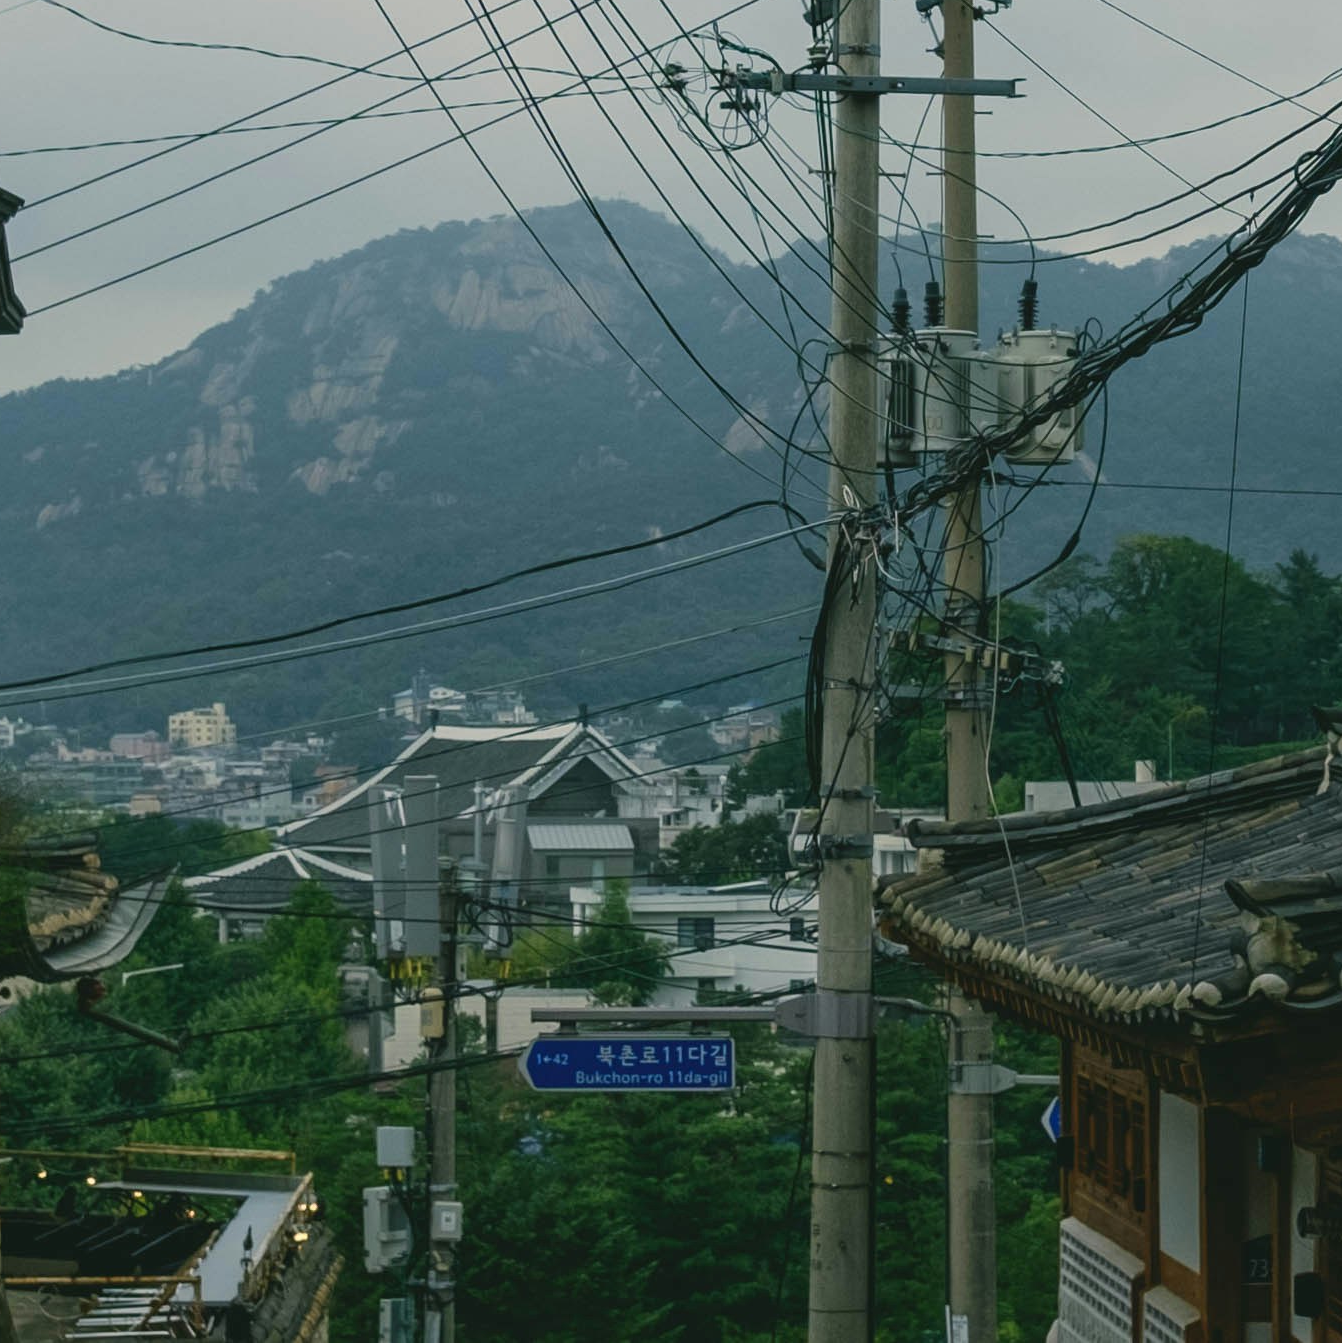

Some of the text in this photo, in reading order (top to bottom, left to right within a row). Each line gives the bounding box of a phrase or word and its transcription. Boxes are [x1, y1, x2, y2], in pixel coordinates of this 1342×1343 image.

[596, 1044, 728, 1066] 북촌로11다길
[575, 1070, 728, 1088] Bukchon-ro 11da-gil
